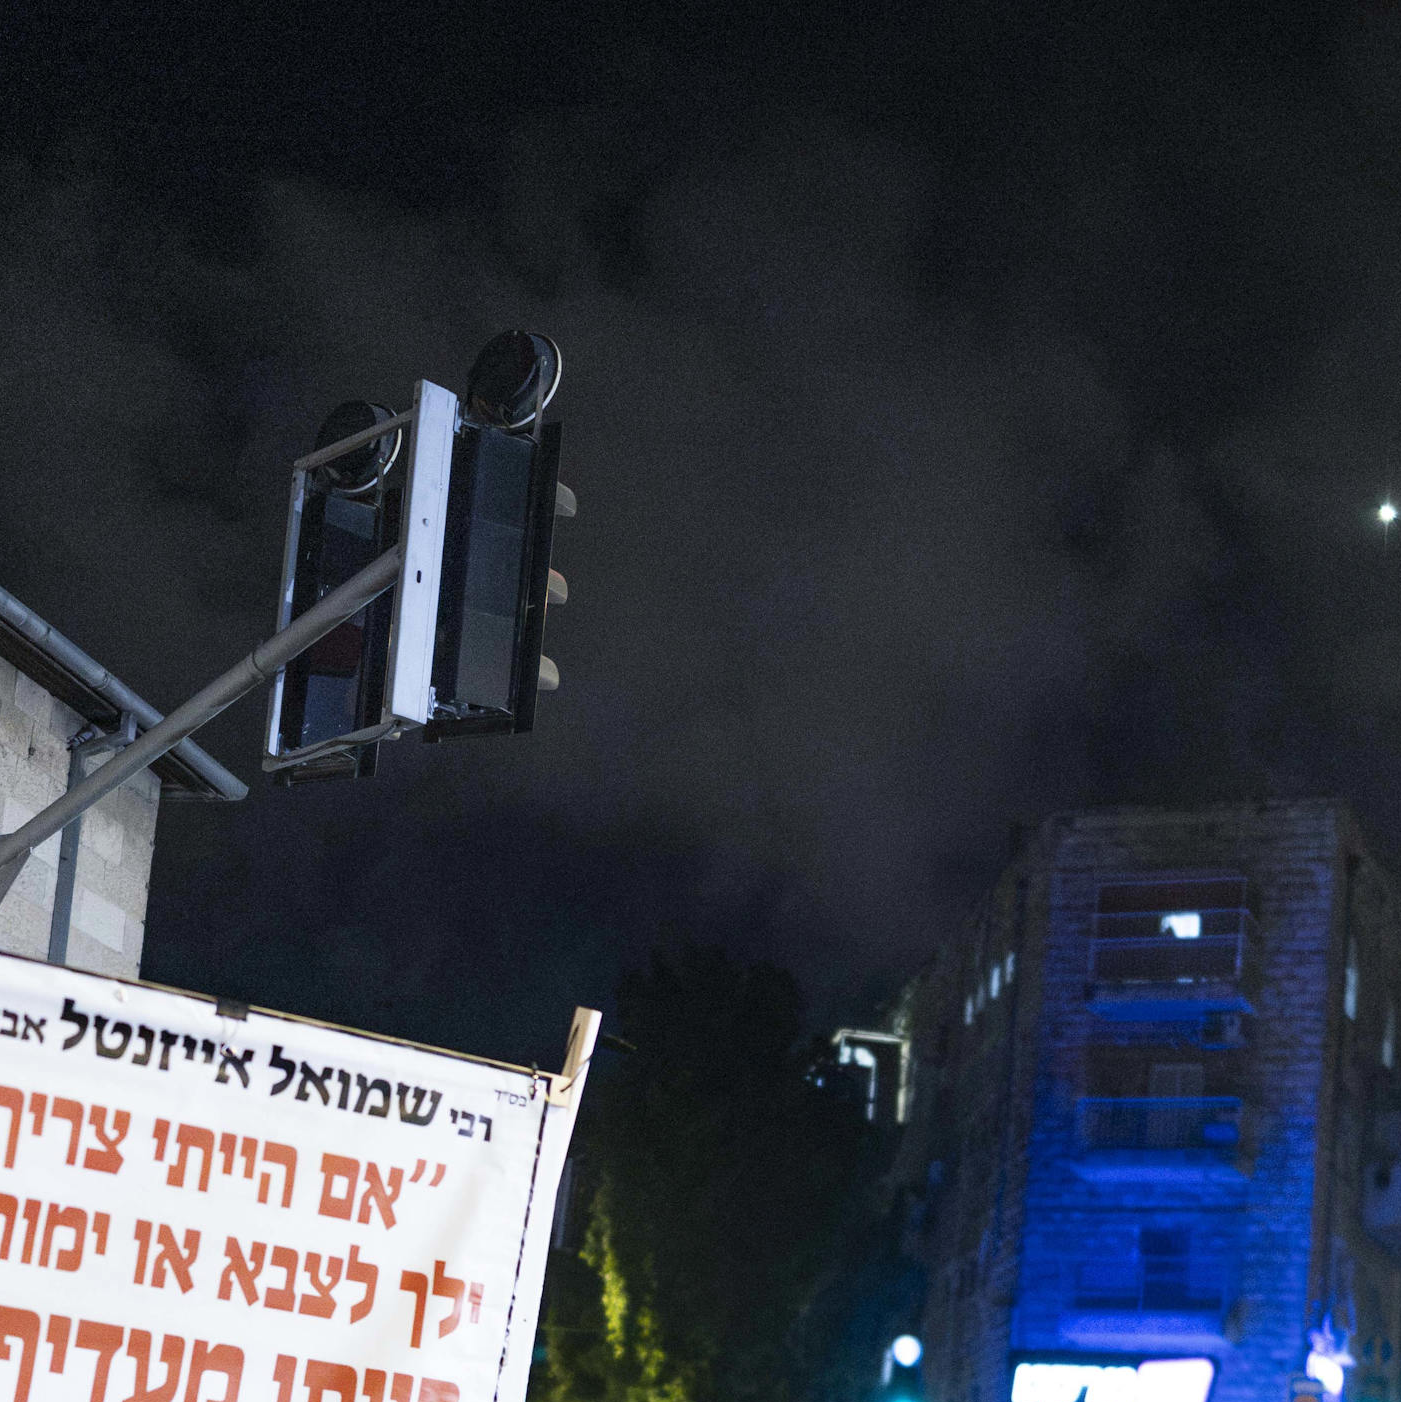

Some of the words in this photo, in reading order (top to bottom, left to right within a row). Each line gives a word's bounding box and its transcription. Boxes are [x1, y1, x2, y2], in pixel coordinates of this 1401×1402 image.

[58, 998, 255, 1091] אייזנטל
[267, 1044, 442, 1128] שמואל
[151, 1116, 299, 1210] הייתי
[450, 1105, 493, 1142] רבי
[132, 1217, 199, 1295] או
[218, 1234, 381, 1328] לצבא
[397, 1259, 486, 1352] ילך
